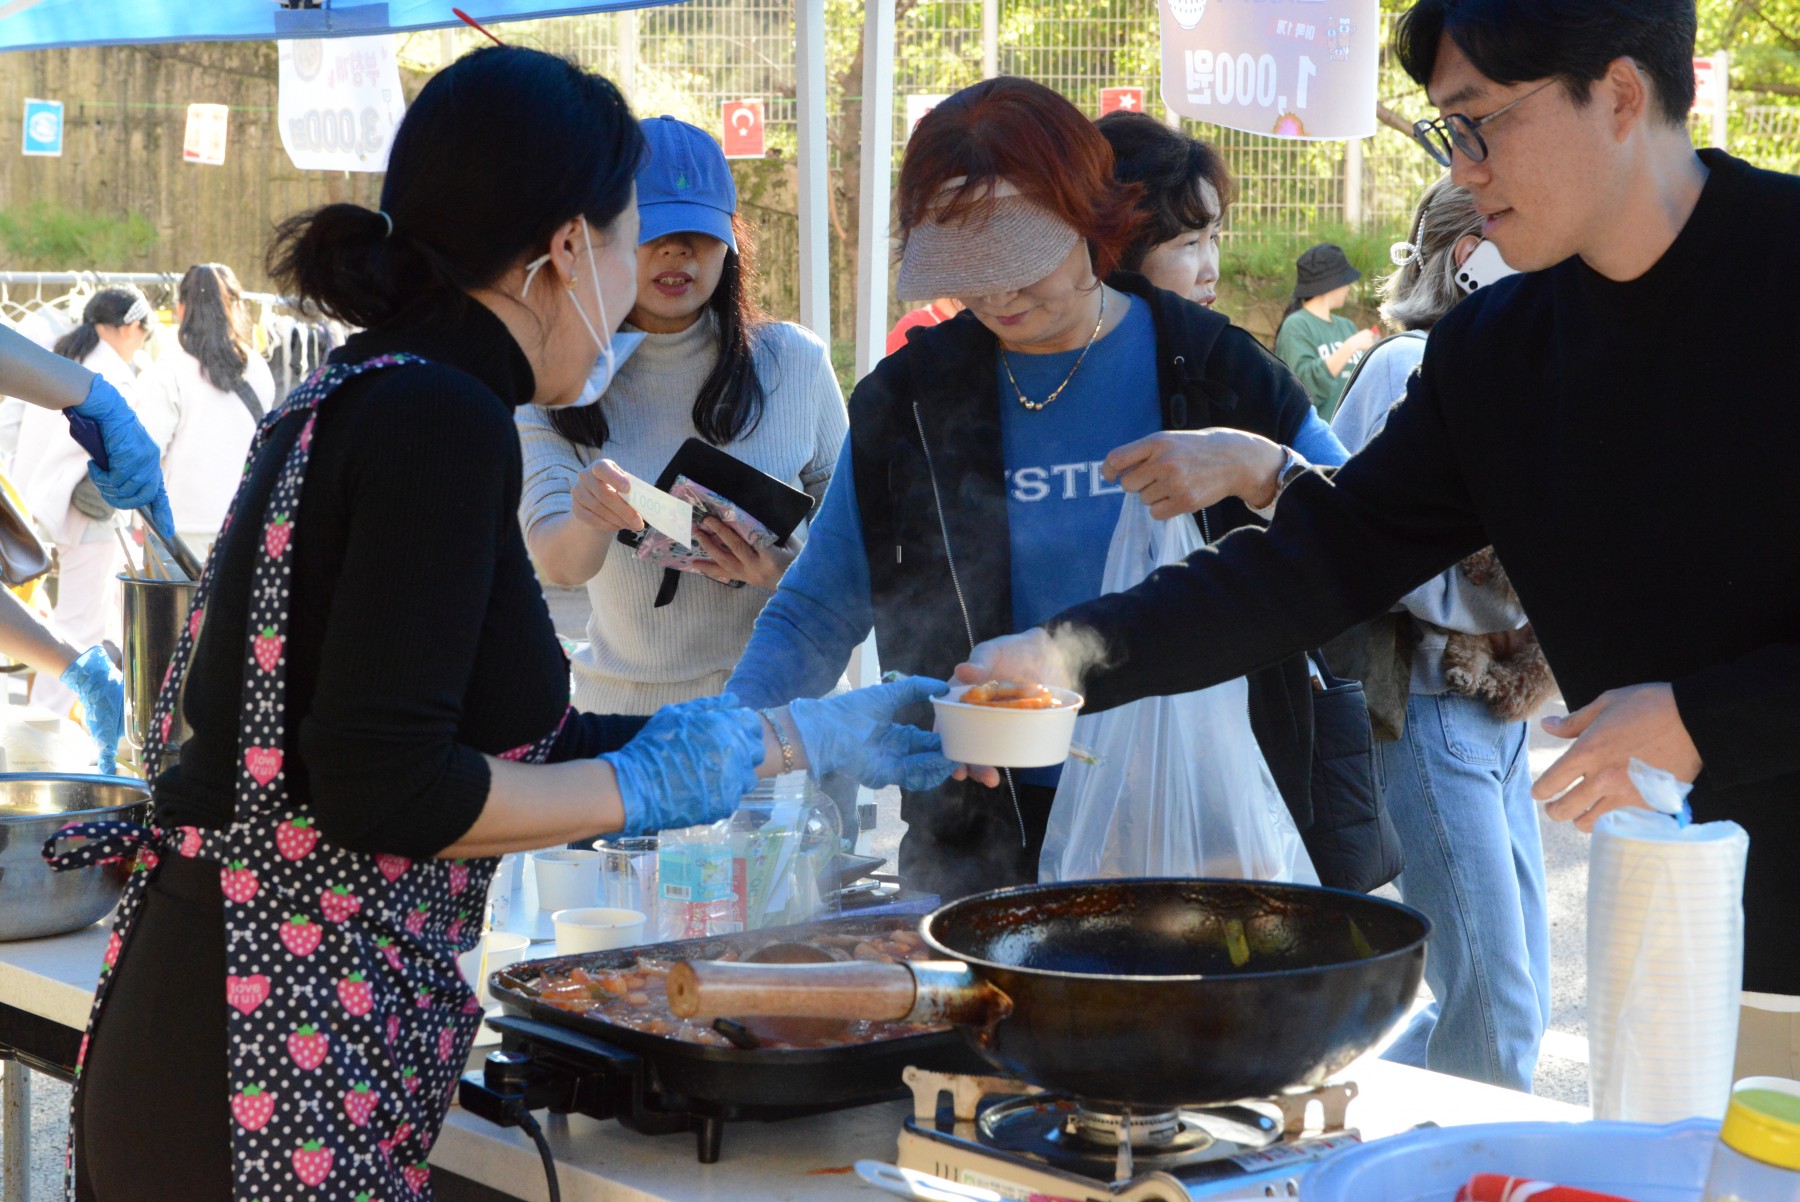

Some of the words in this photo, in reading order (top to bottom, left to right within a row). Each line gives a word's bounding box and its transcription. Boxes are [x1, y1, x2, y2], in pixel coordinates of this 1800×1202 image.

[253, 754, 276, 766] love
[231, 982, 261, 994] love
[228, 993, 263, 1005] fruit
